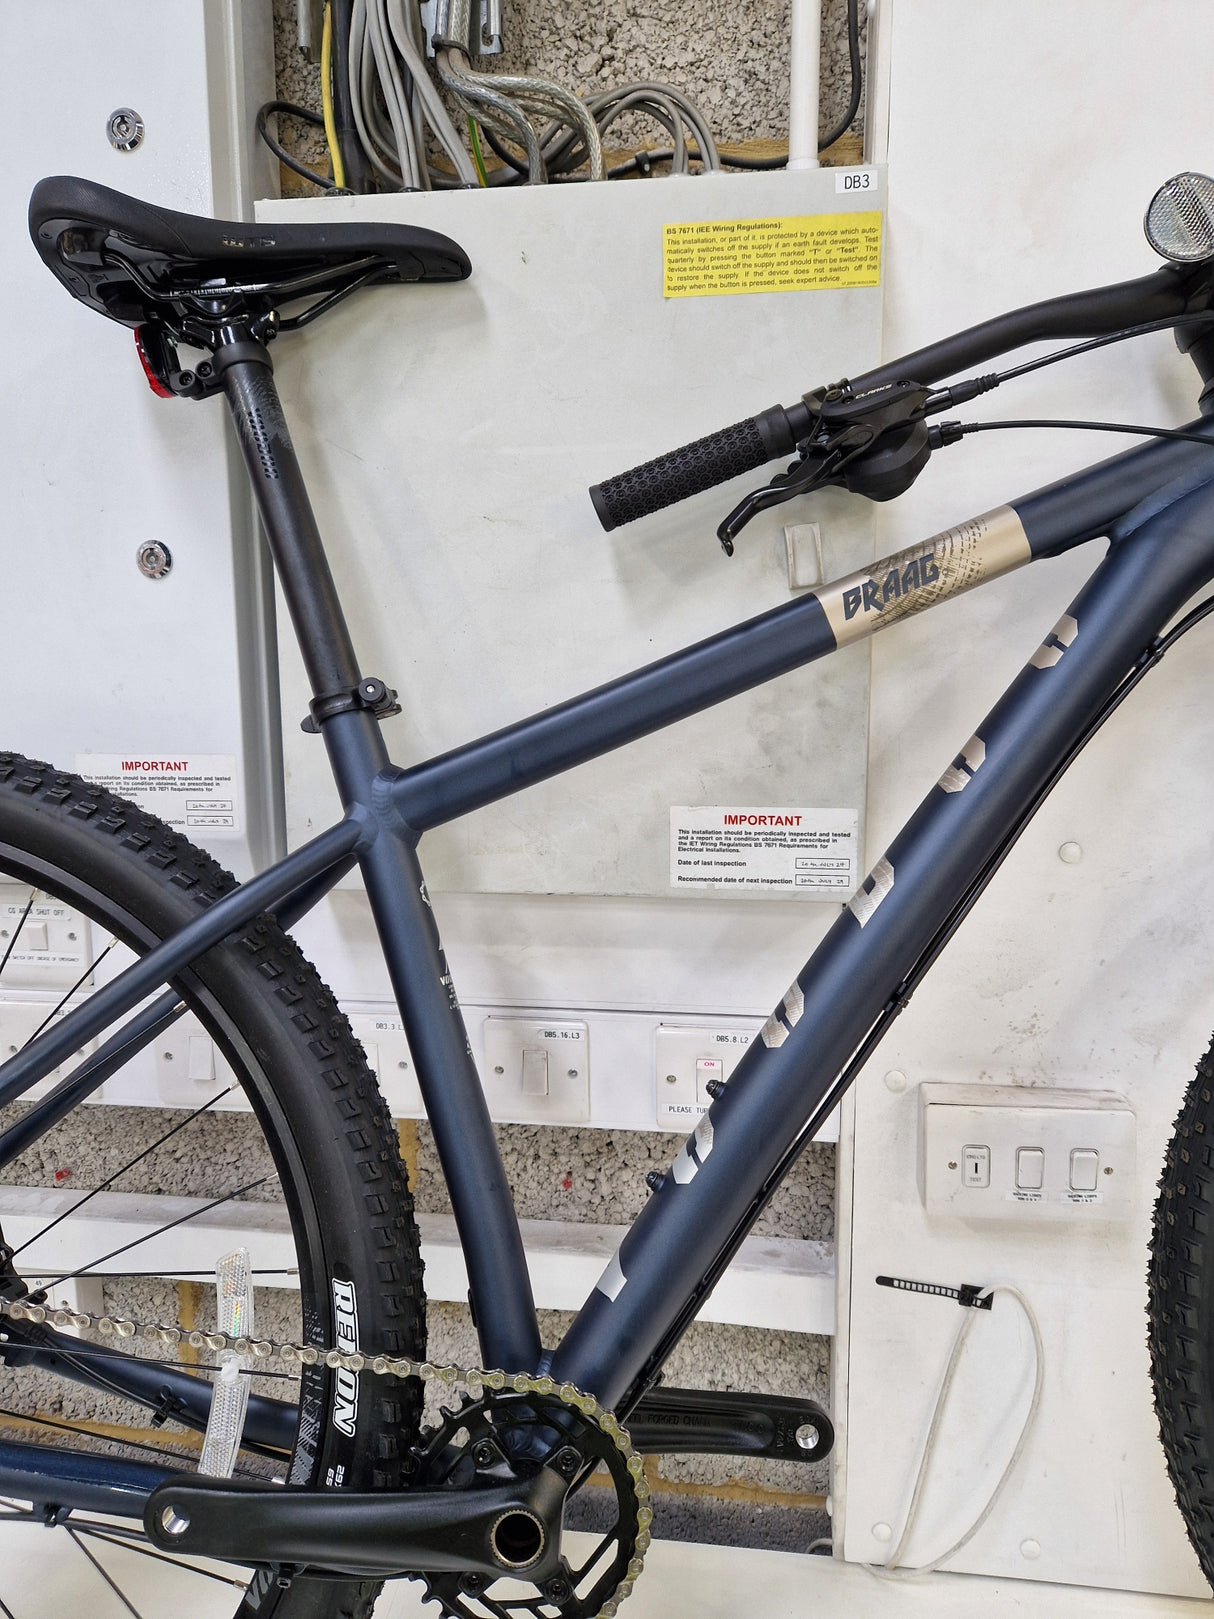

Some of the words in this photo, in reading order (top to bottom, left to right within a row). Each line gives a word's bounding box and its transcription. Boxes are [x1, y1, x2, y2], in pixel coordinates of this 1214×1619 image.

[844, 174, 870, 190] DB3
[736, 222, 783, 231] Regulations):
[768, 232, 797, 240] protected
[749, 279, 777, 287] pressed,
[842, 552, 940, 621] BRAAG
[122, 761, 188, 772] IMPORTANT
[724, 815, 802, 826] IMPORTANT
[544, 1031, 580, 1040] DB5.16.L3
[716, 1035, 748, 1044] DB5.8.L2
